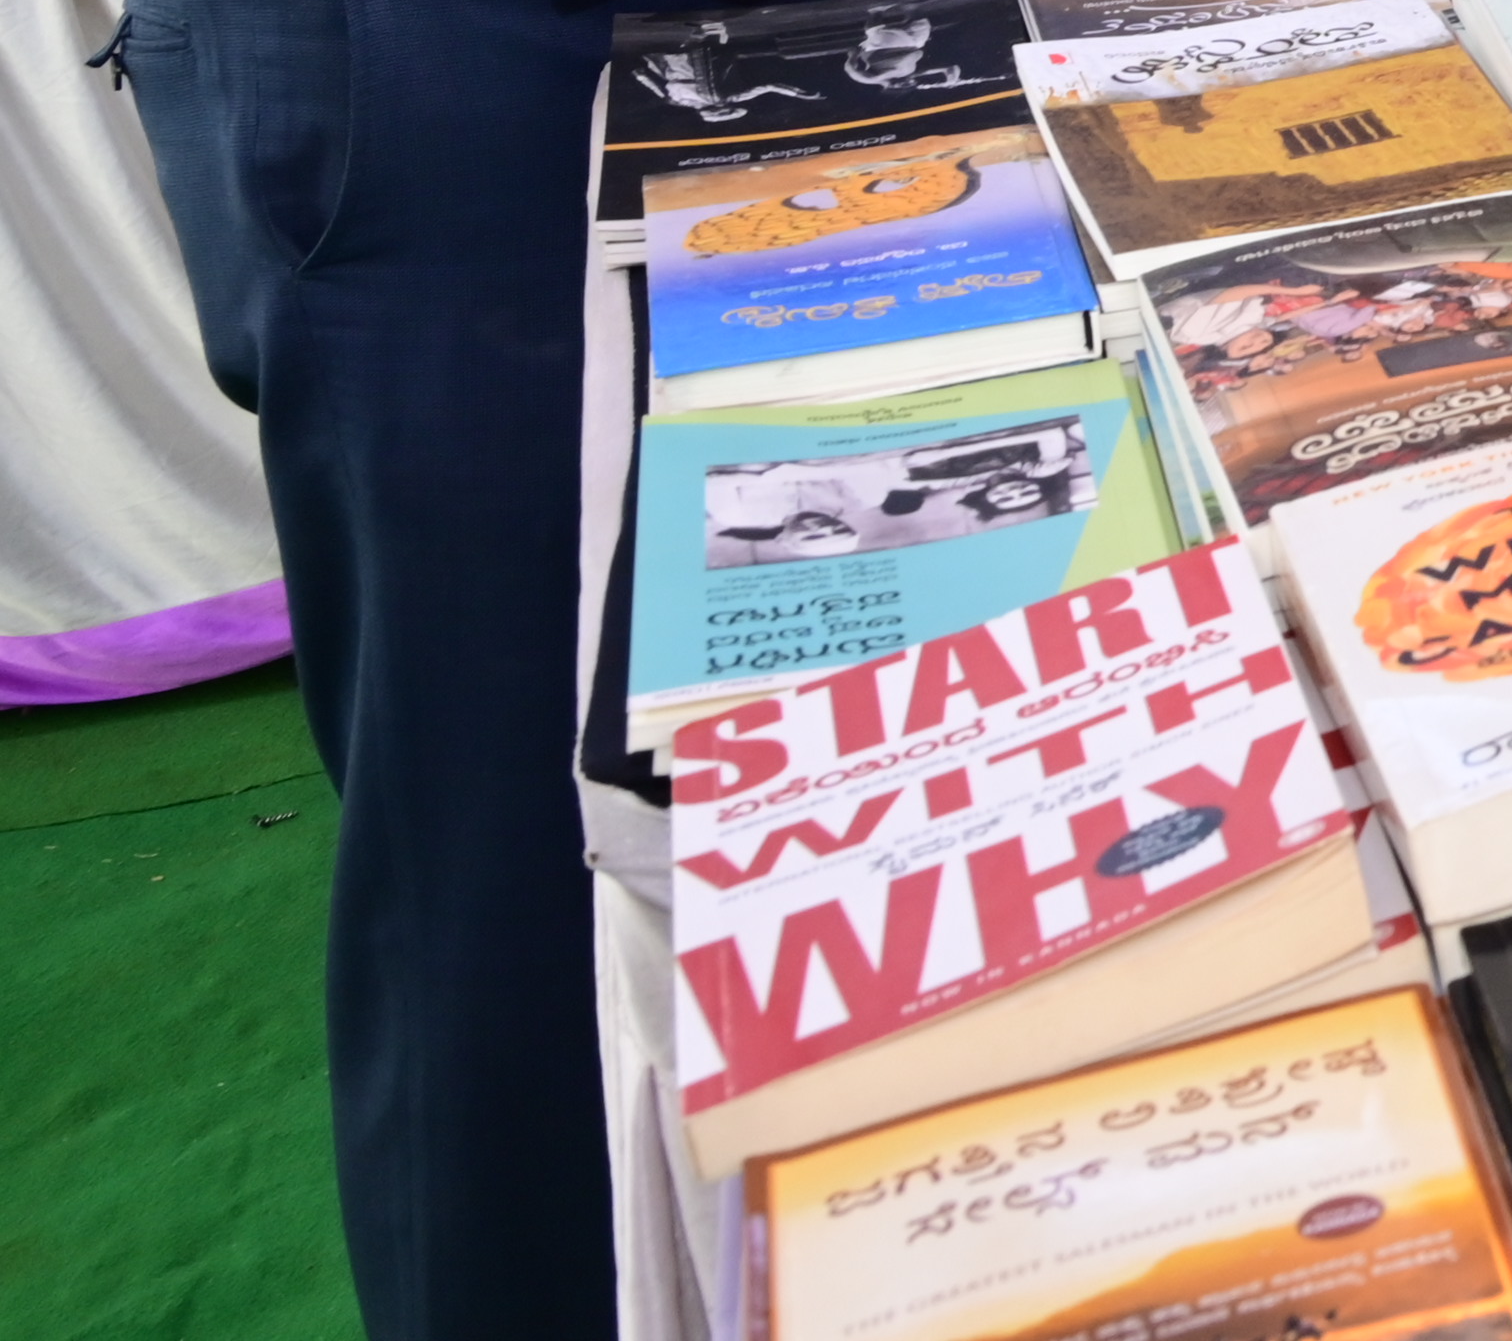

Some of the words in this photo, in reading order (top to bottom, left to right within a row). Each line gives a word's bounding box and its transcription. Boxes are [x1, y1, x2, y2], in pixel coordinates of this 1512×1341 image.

[671, 533, 1241, 806] START
[675, 645, 1295, 892] WITH
[675, 717, 1306, 1075] WHY
[900, 981, 961, 1016] NOW
[1018, 902, 1150, 963] KANNADA
[823, 1120, 1067, 1220] ಜಗತ್ತಿನ
